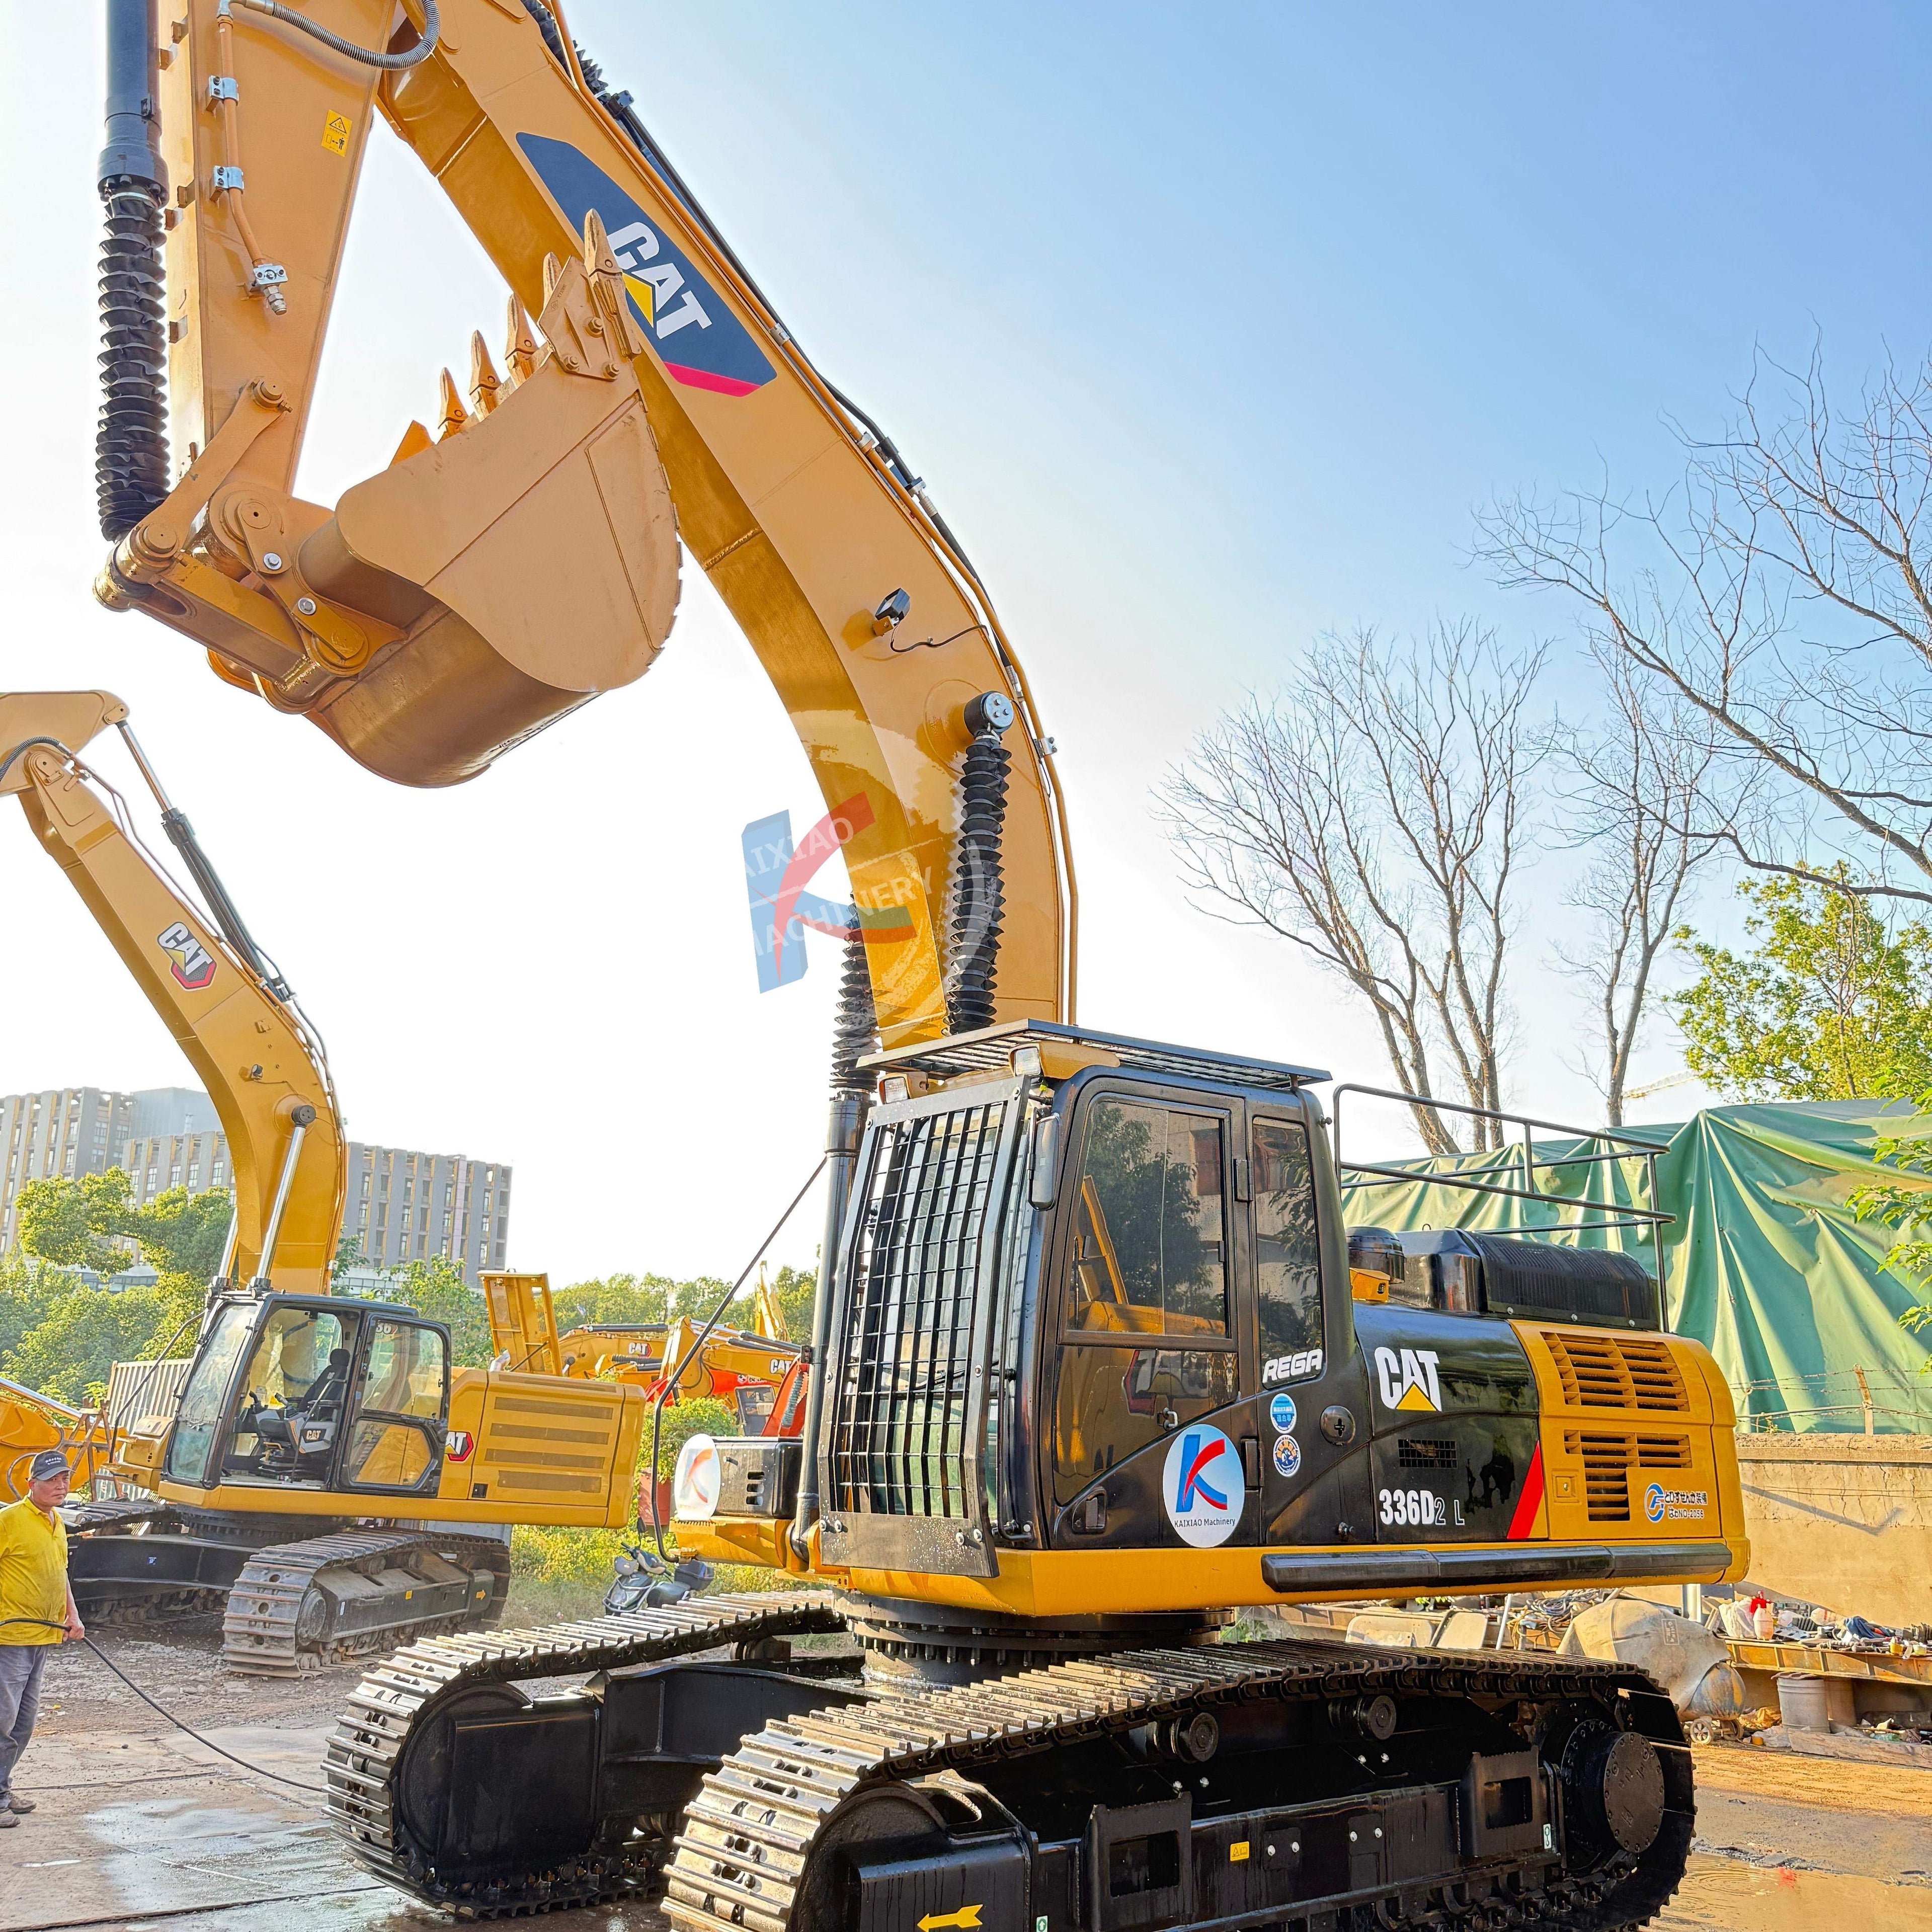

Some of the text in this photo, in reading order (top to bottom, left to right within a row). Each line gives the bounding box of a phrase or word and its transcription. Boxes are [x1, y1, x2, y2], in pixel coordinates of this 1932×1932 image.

[607, 222, 712, 339] CAT
[158, 923, 212, 976] CAT
[628, 1342, 648, 1355] CAT
[1262, 1349, 1323, 1383] REGA
[1375, 1347, 1442, 1412] CAT
[306, 1430, 321, 1440] CAT
[445, 1431, 467, 1455] AT
[1174, 1517, 1236, 1527] KAIXIAO Machinery
[1379, 1489, 1465, 1525] 336D2 L
